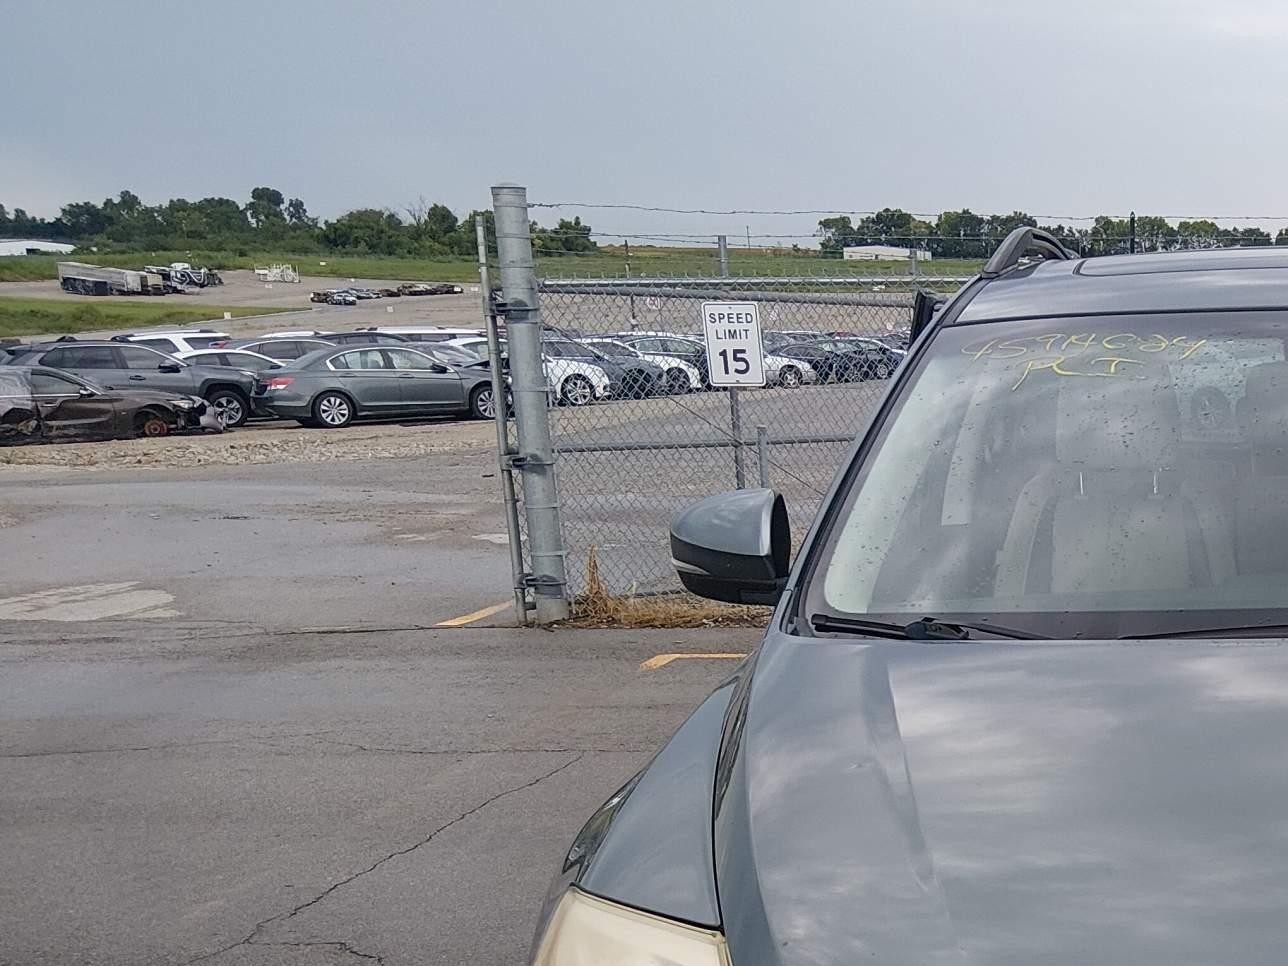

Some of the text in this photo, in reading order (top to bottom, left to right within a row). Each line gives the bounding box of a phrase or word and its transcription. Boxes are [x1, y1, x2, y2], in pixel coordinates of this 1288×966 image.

[708, 312, 753, 324] SPEED
[716, 328, 750, 340] LIMIT
[718, 348, 750, 375] 15
